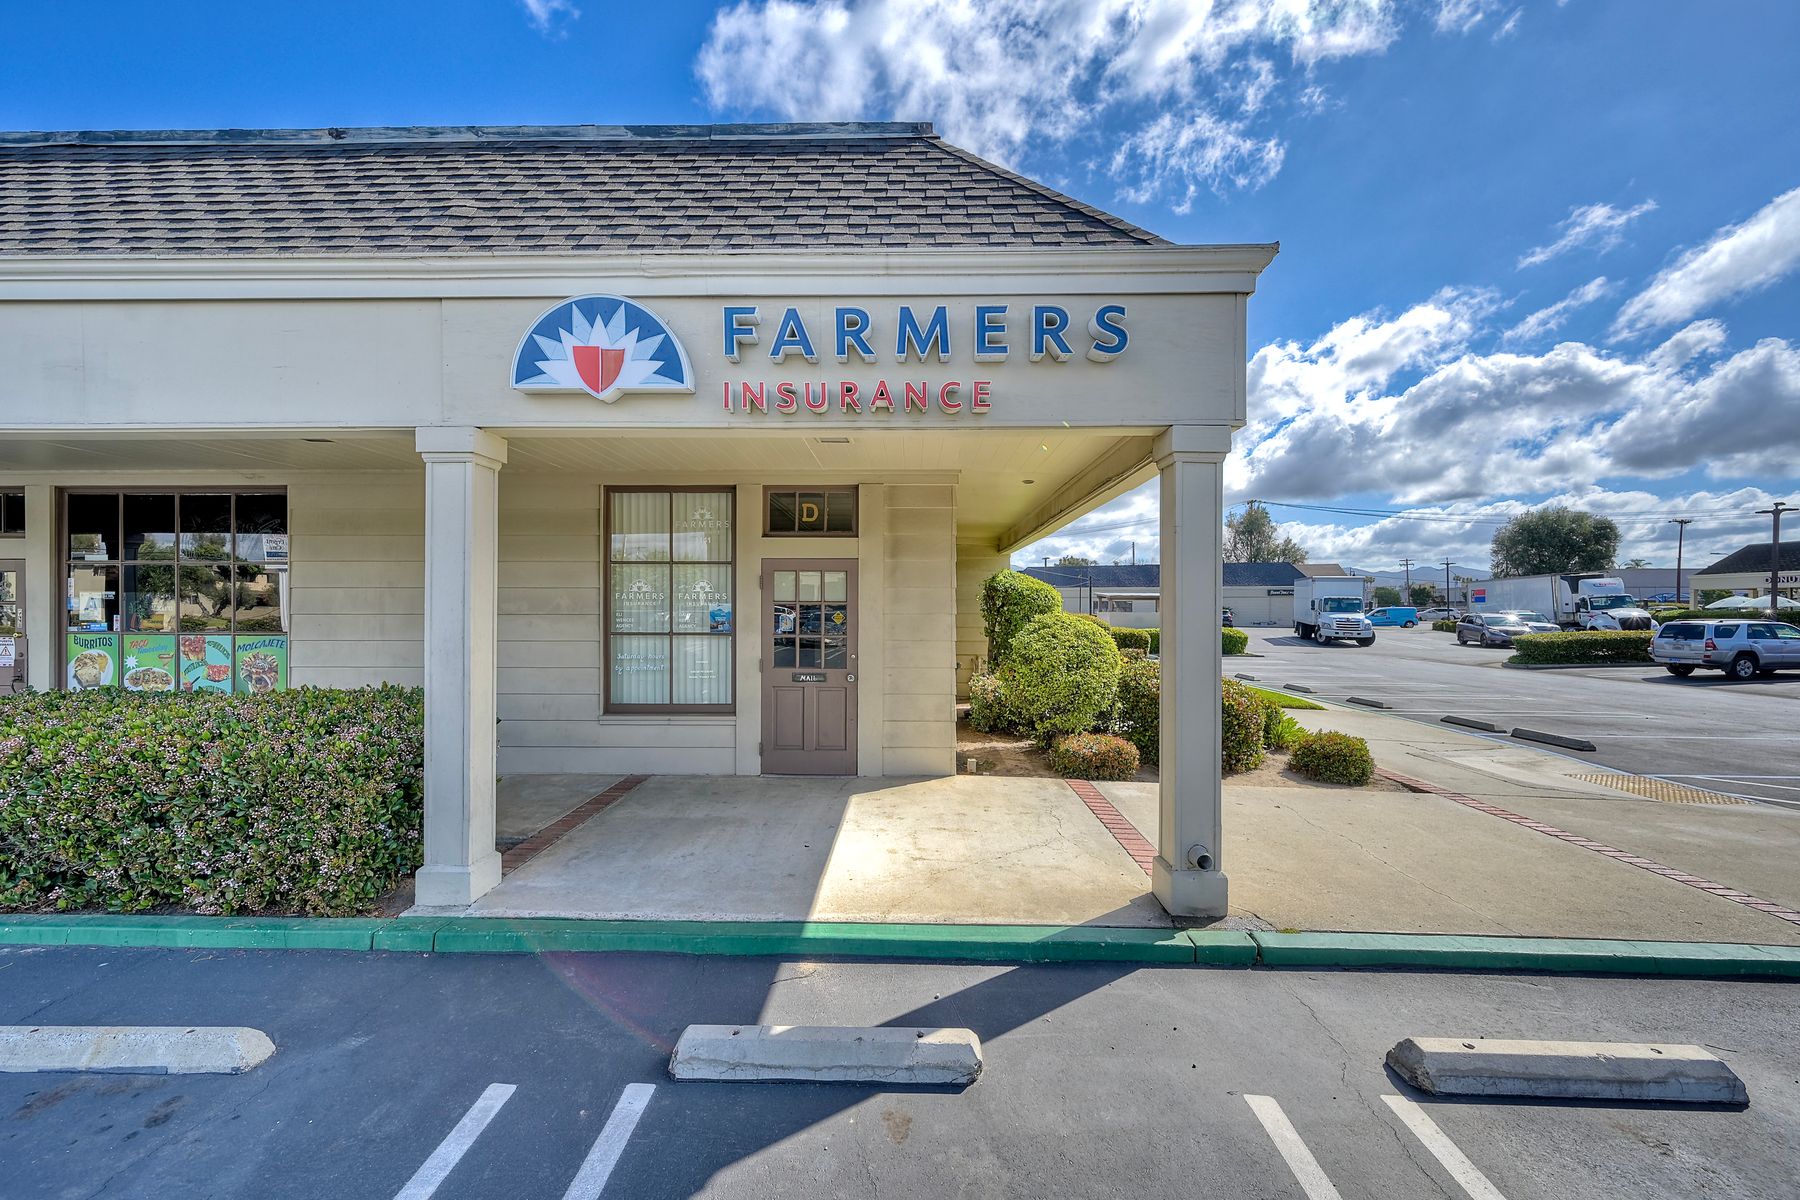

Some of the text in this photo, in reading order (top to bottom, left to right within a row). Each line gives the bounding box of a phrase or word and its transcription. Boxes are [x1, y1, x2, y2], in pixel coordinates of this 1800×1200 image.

[722, 303, 1130, 363] FARMERS
[723, 380, 993, 415] INSURANCE
[802, 503, 818, 521] D
[675, 520, 731, 529] FARMERS
[615, 592, 665, 600] FARMERS
[678, 592, 728, 600] FARMERS
[73, 635, 113, 650] BURRITOS
[236, 638, 286, 653] MOLCAJETE
